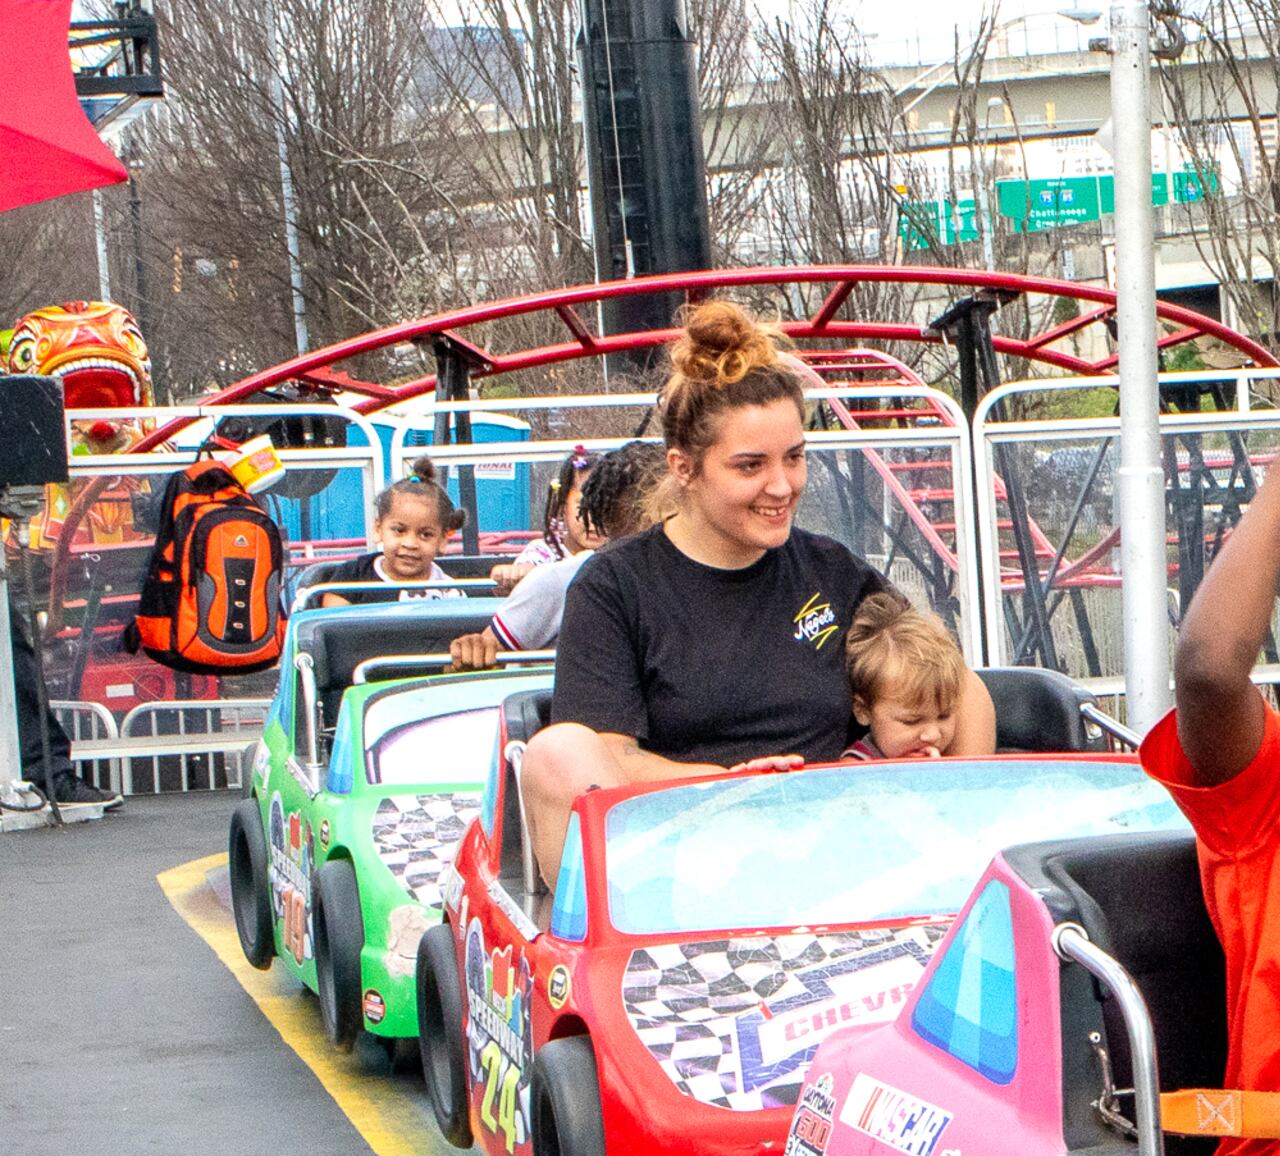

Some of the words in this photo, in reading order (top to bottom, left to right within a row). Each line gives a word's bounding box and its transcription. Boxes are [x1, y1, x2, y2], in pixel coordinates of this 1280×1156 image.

[469, 988, 525, 1070] SPEEDWAY
[480, 1039, 522, 1156] 24
[796, 1107, 832, 1151] 500
[803, 1087, 835, 1115] DAYTONA
